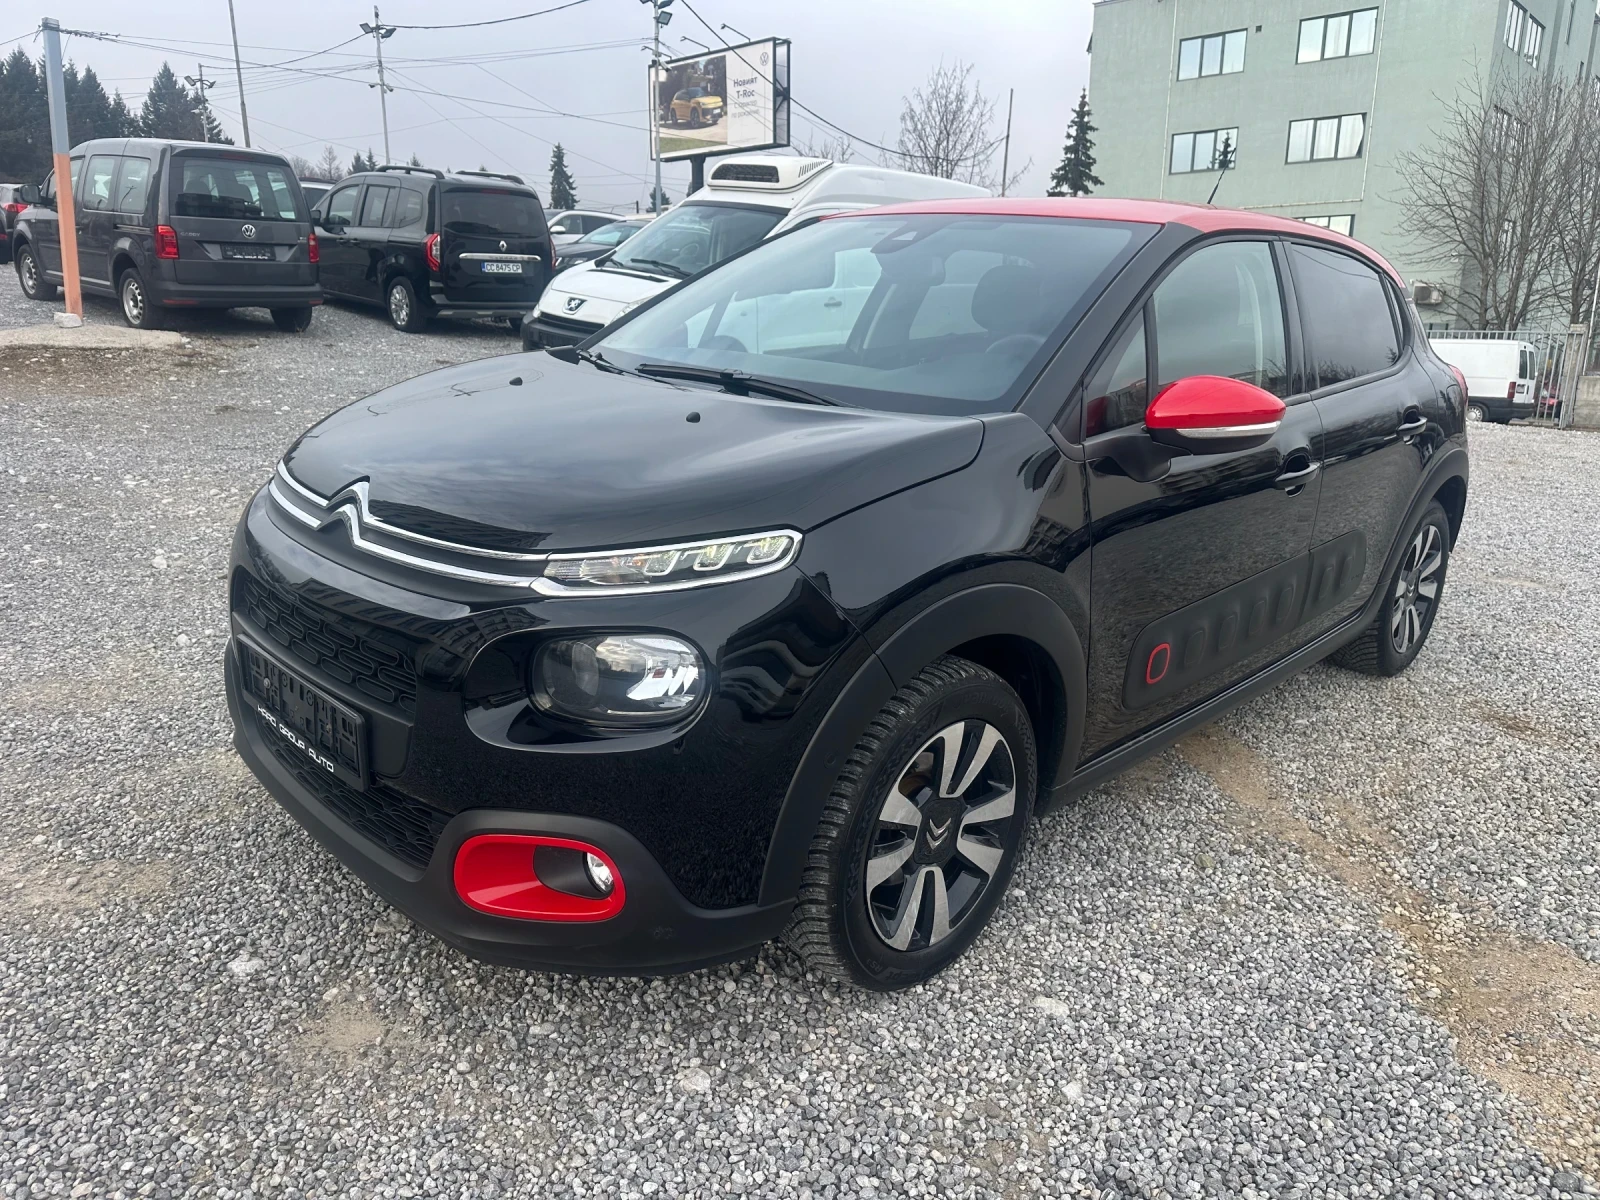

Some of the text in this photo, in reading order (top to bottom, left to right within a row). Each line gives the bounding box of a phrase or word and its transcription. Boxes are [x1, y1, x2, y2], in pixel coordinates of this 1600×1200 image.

[736, 89, 755, 99] T-Roc
[486, 263, 521, 272] CC 8475 CP
[278, 723, 306, 750] GROUP
[308, 747, 334, 773] AUTO
